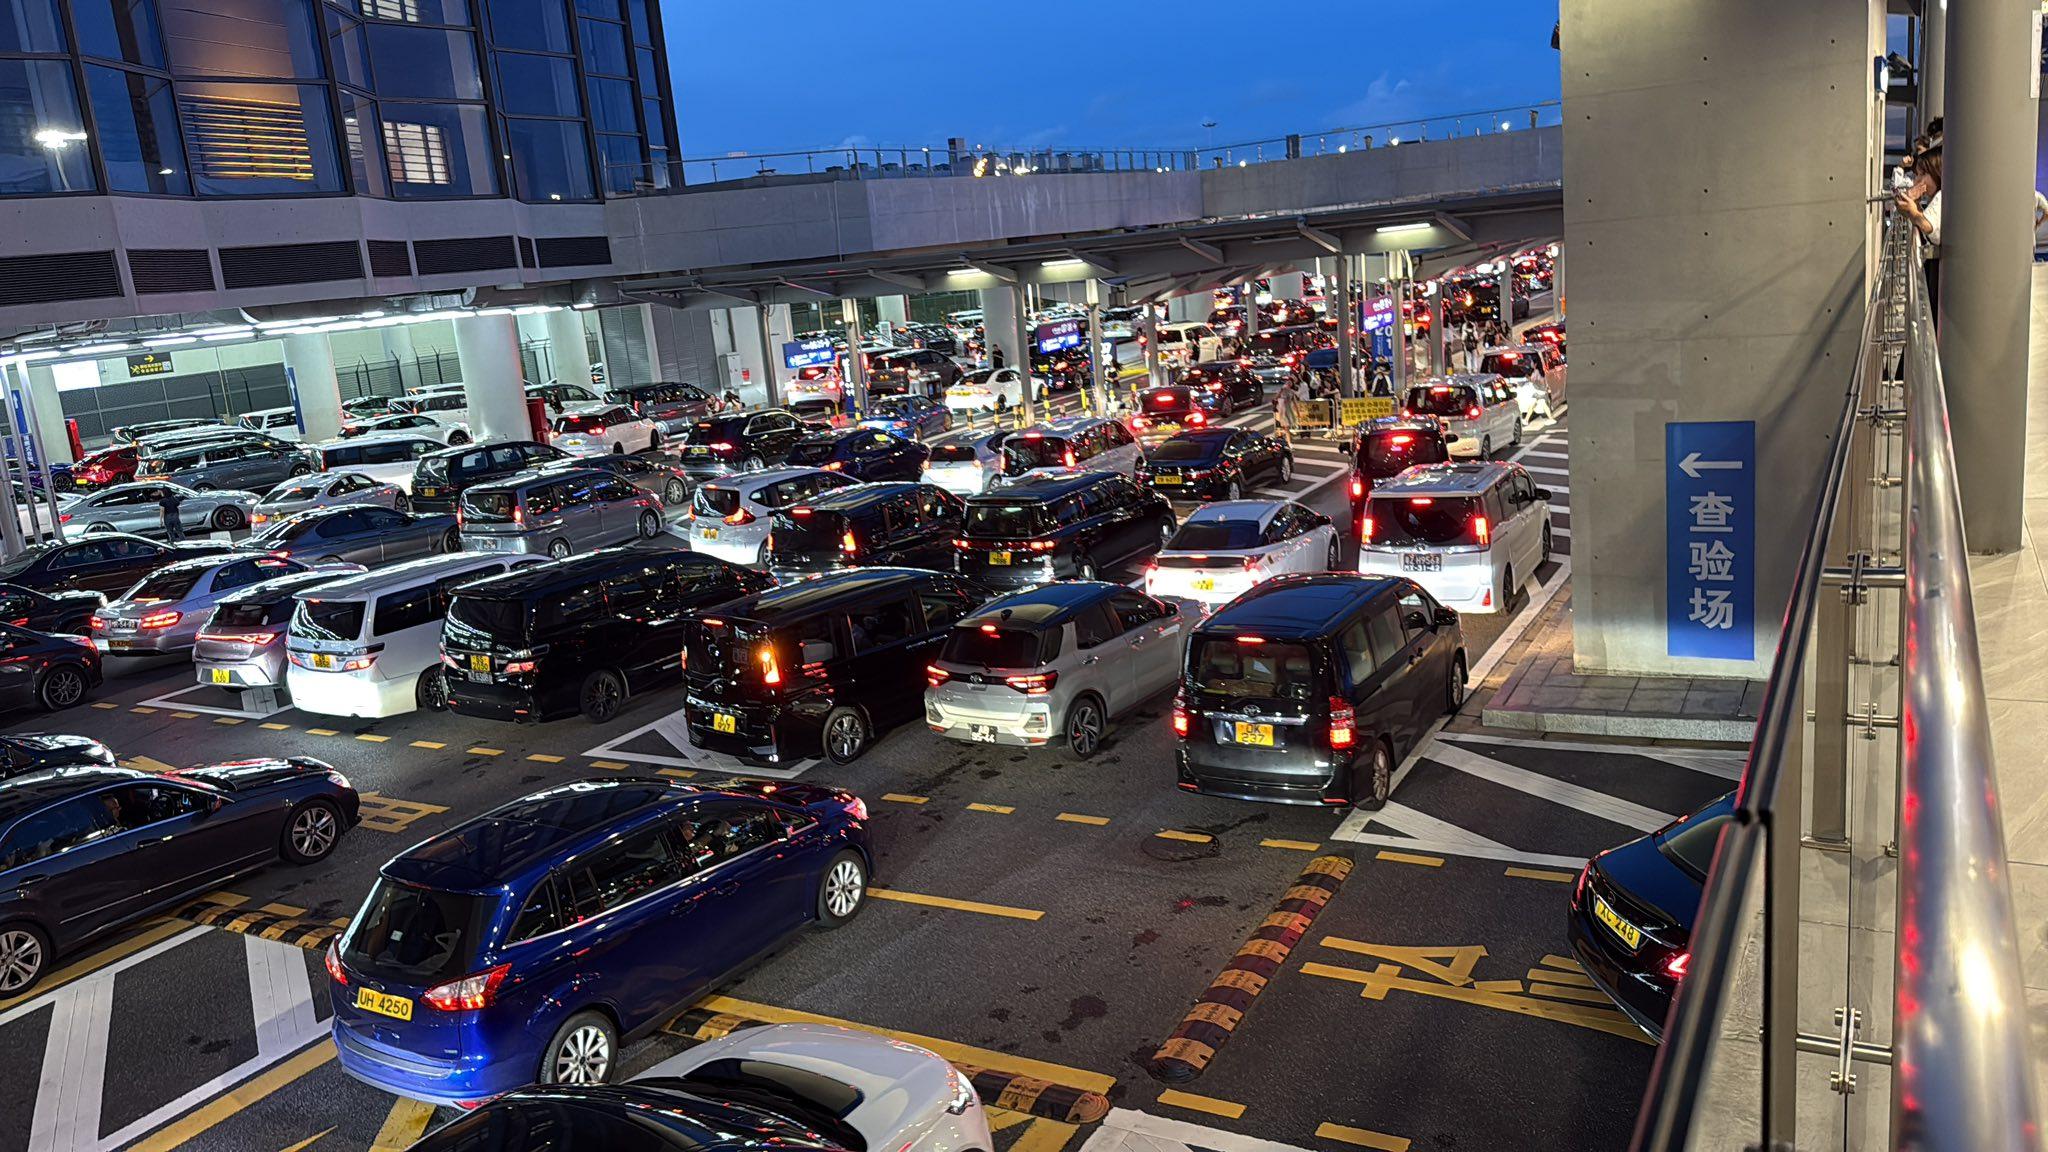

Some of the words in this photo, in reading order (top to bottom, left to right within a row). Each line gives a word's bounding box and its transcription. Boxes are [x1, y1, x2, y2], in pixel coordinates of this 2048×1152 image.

[1688, 490, 1735, 630] 查验场
[1242, 733, 1265, 743] 237
[1246, 723, 1261, 734] OK
[1600, 905, 1612, 922] XC
[1614, 918, 1635, 941] 248
[360, 990, 375, 1007] UH
[378, 996, 409, 1016] 4250
